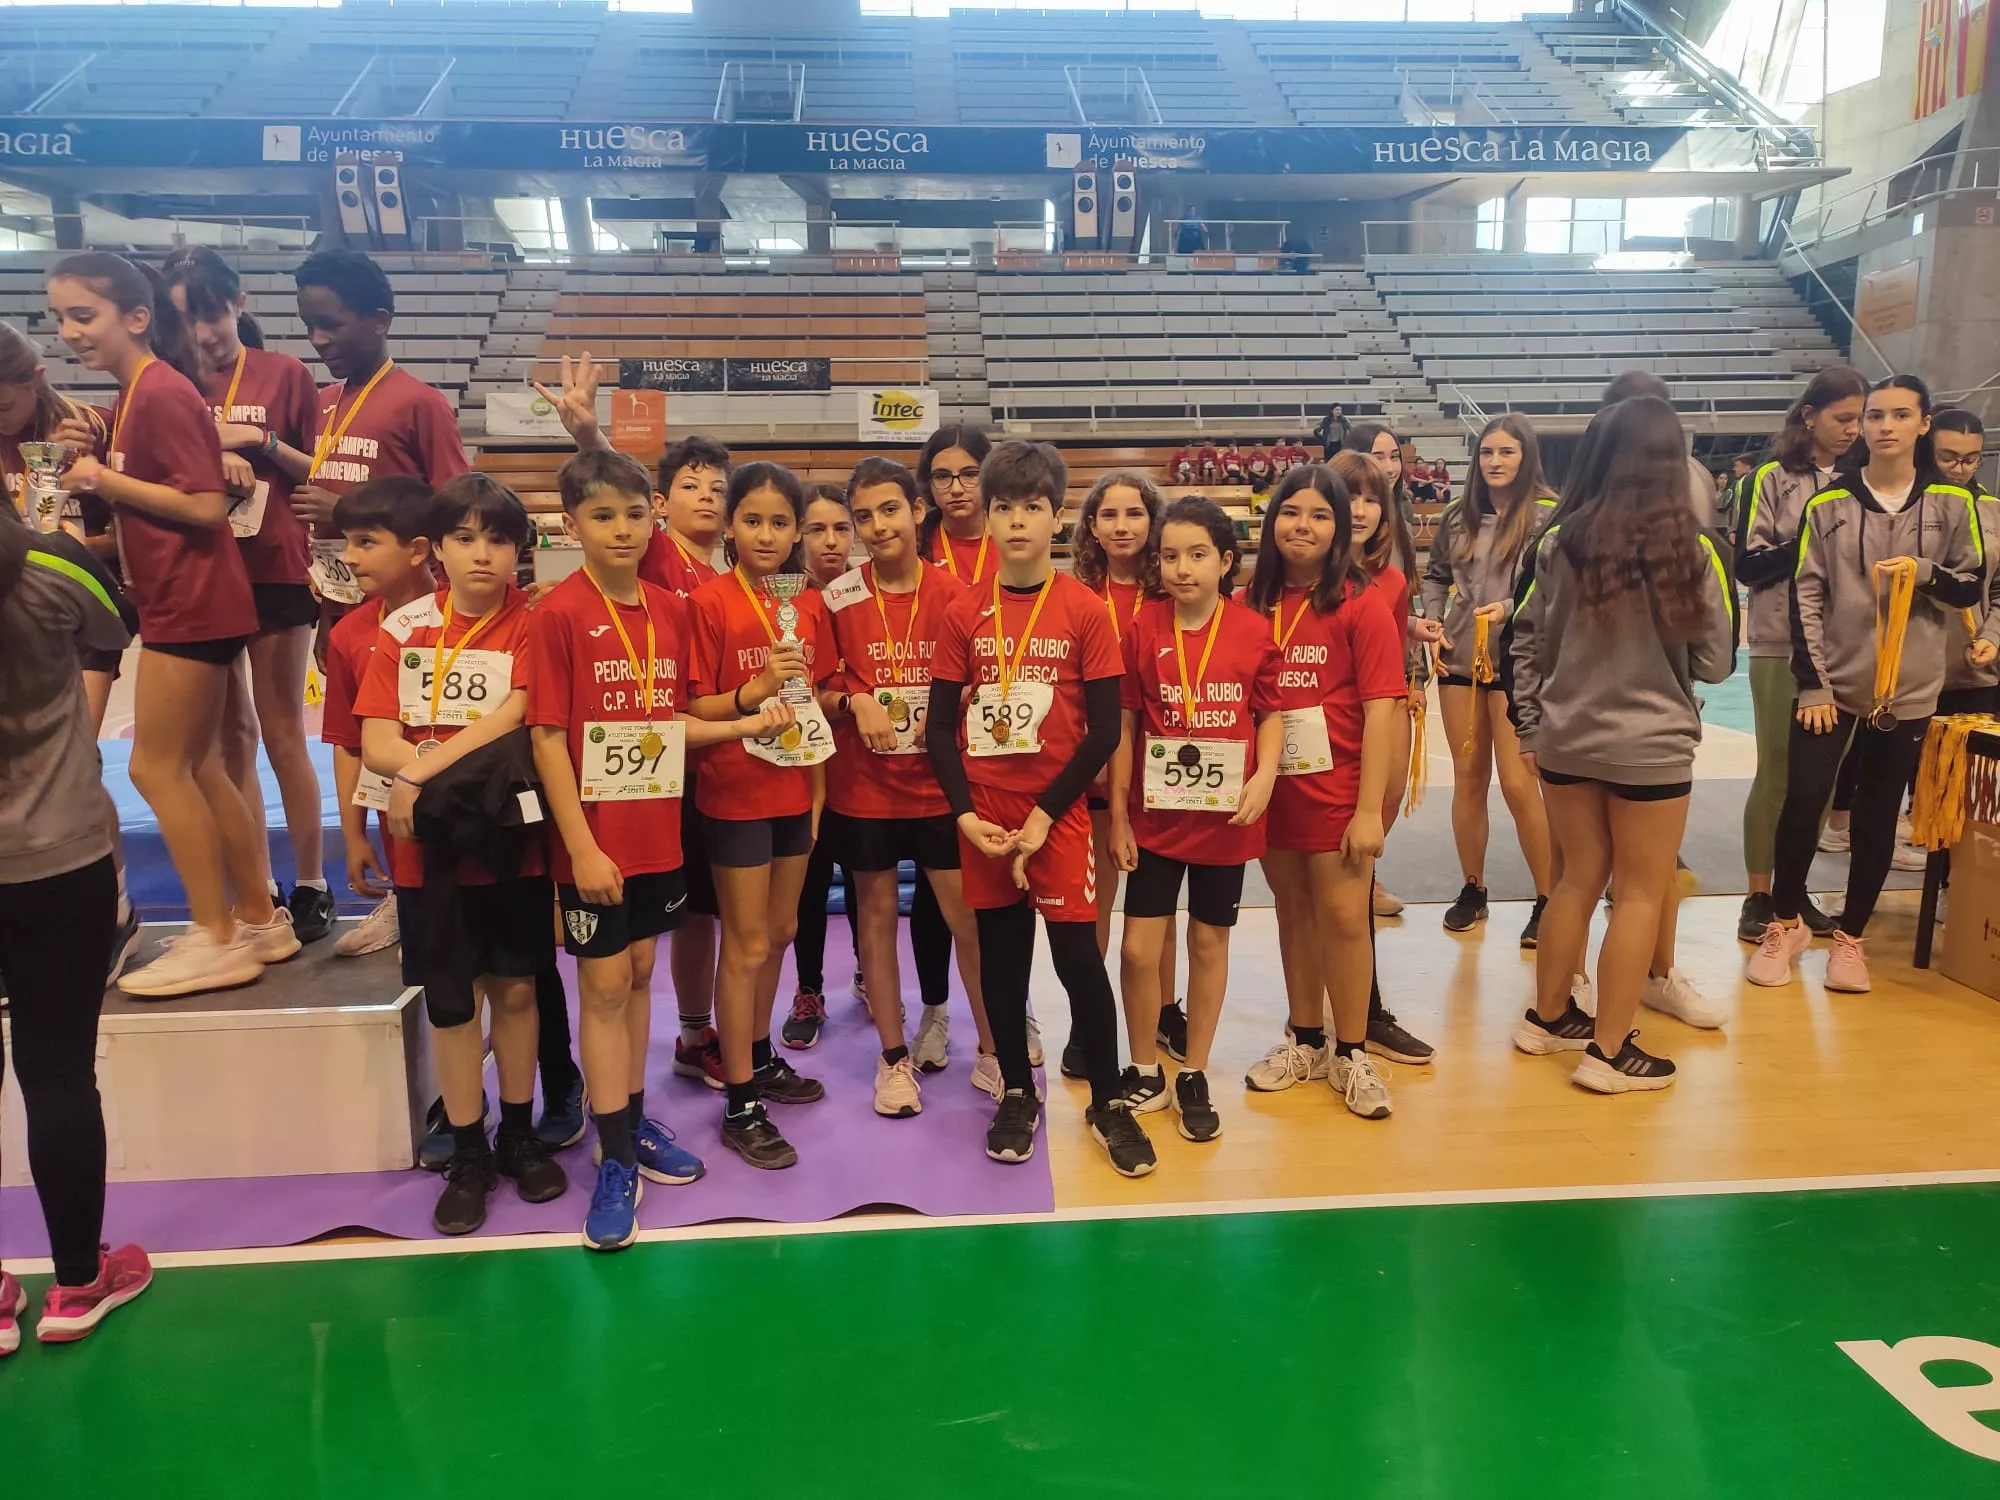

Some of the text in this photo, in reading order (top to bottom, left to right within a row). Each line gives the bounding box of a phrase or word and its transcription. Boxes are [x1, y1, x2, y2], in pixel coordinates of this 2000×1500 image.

[308, 126, 435, 145] Ayuntamiento
[1088, 133, 1206, 152] Ayuntamiento
[307, 147, 328, 162] de
[1089, 153, 1109, 168] de
[338, 435, 379, 459] SAMPER
[974, 636, 1070, 660] PEDO RUBIO
[1291, 645, 1328, 665] RUBIO
[875, 666, 933, 684] C.P. HUES
[421, 671, 487, 701] 588
[1206, 682, 1243, 702] RUBIO
[603, 688, 674, 712] C.P. HESC
[982, 703, 1034, 733] 589
[1164, 709, 1182, 727] C.P.
[604, 745, 667, 776] 597
[1164, 761, 1224, 788] 595
